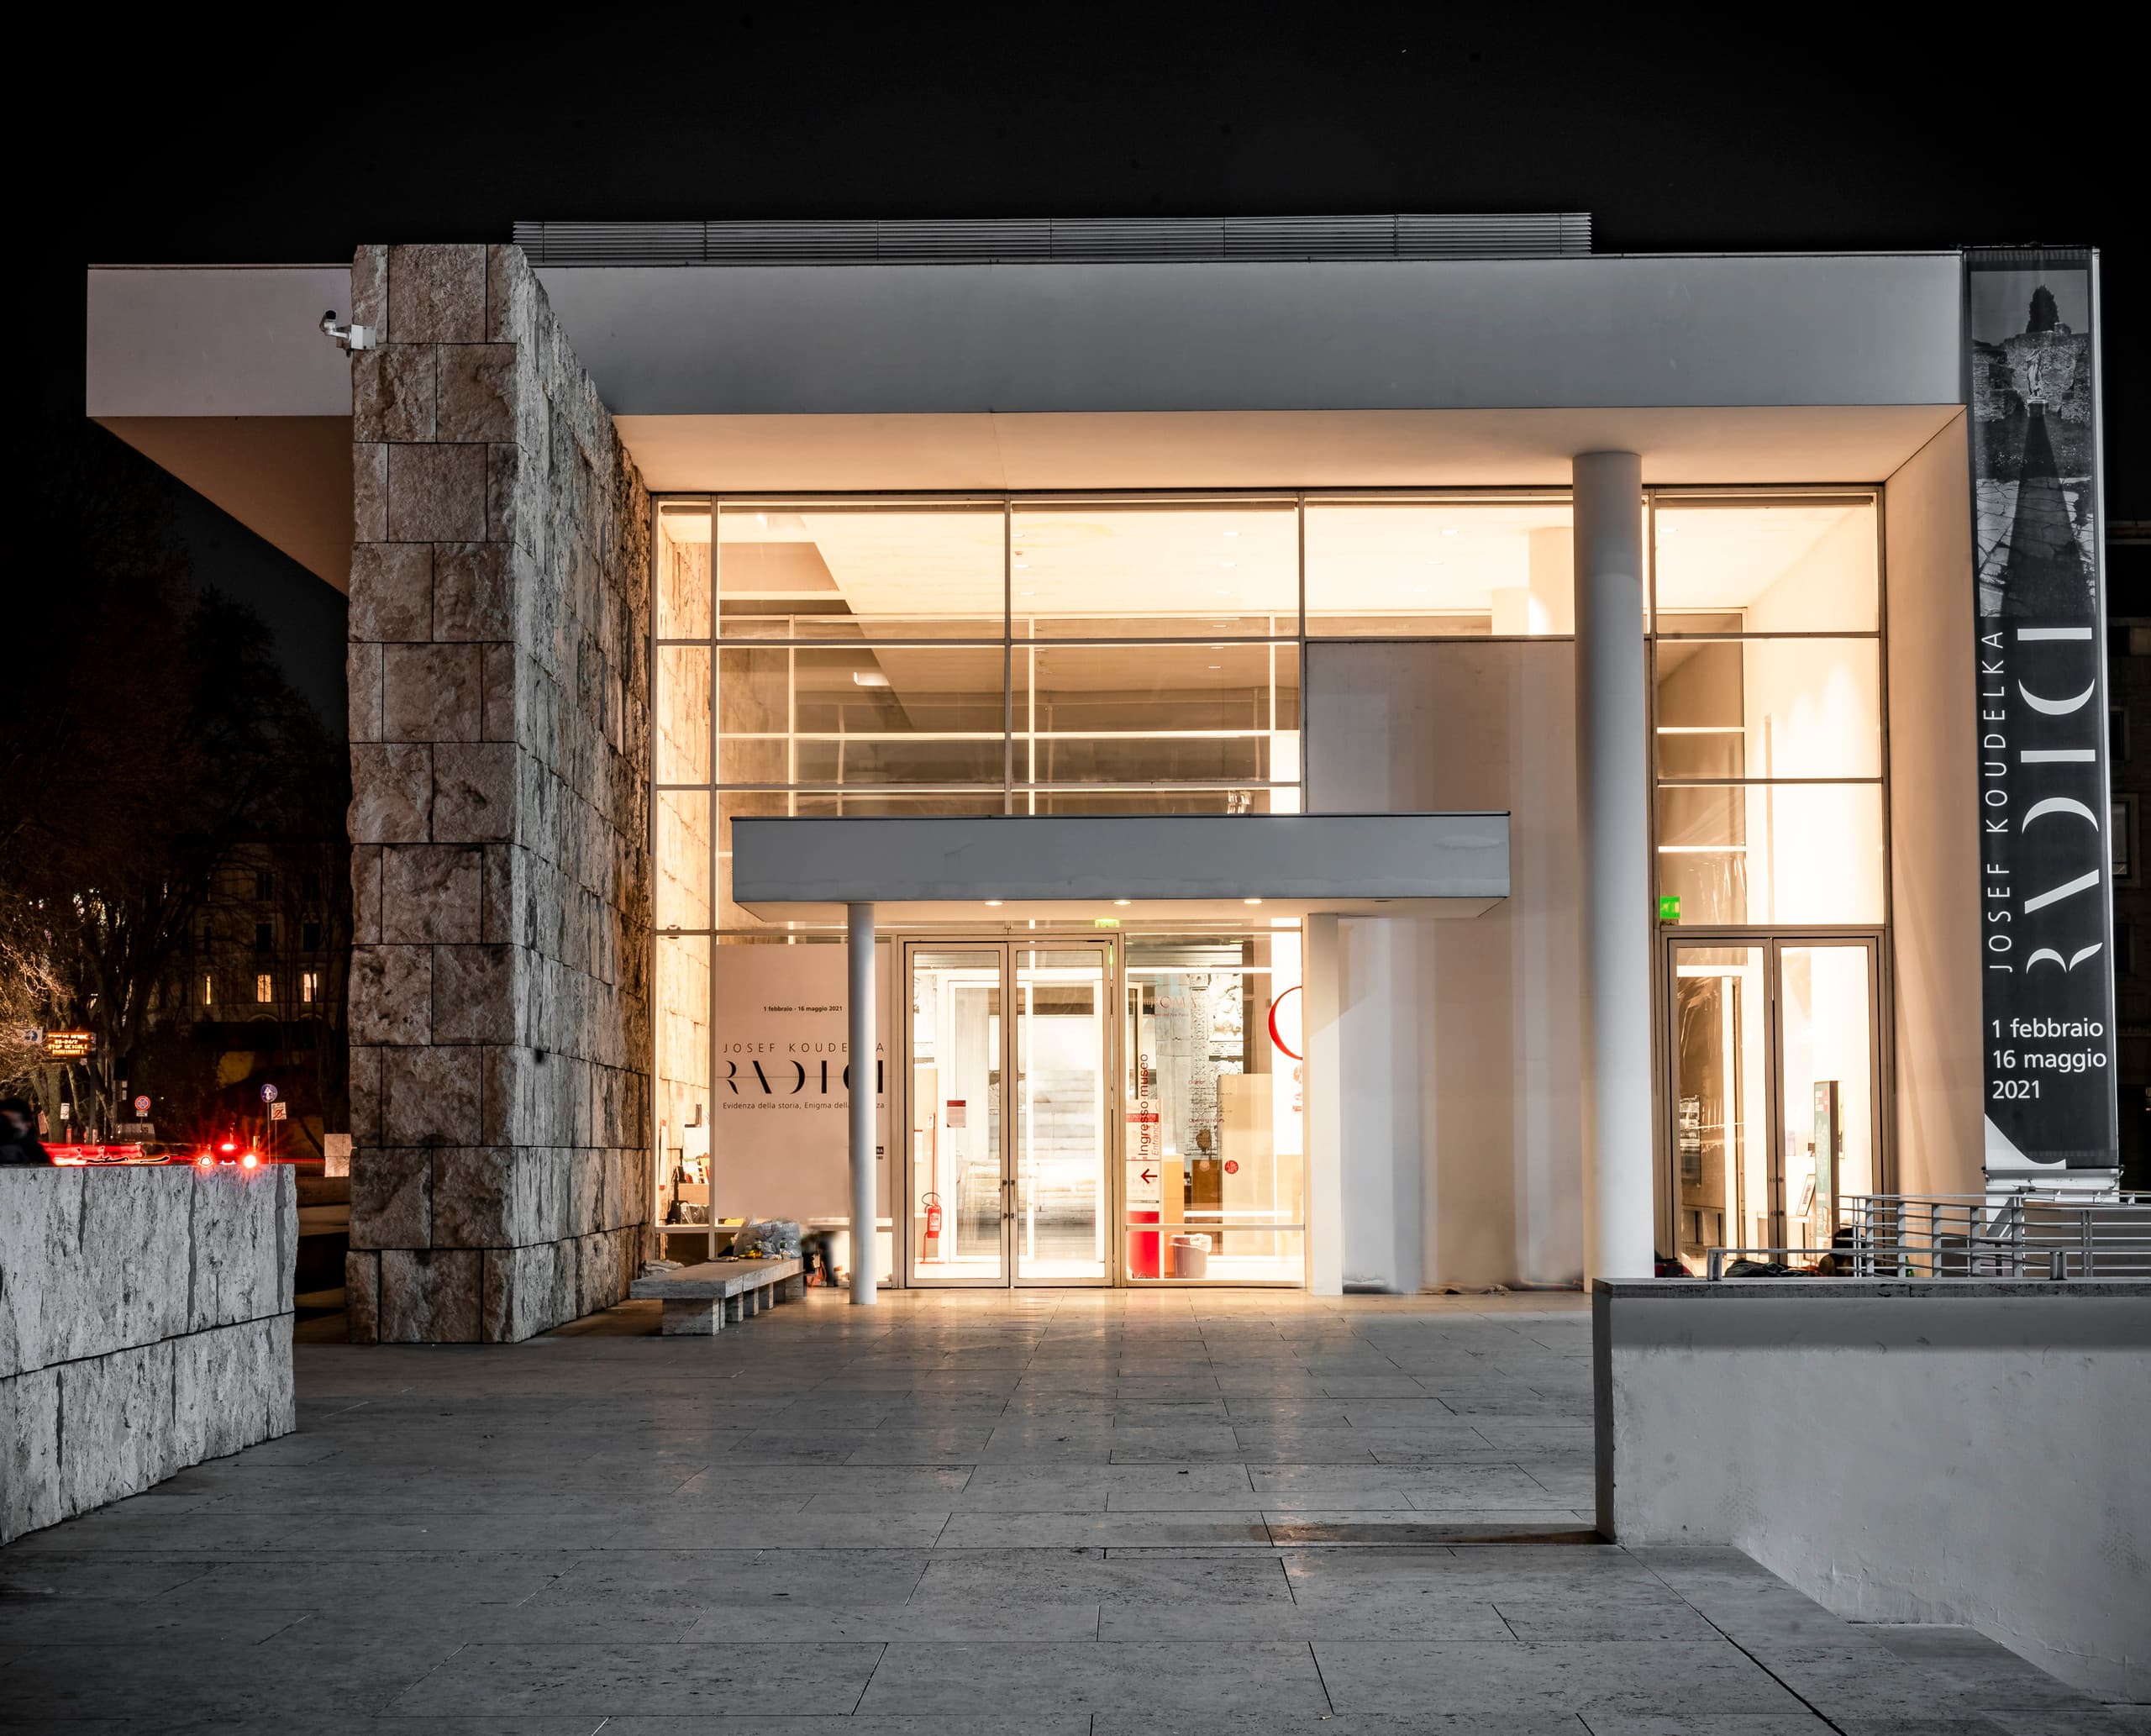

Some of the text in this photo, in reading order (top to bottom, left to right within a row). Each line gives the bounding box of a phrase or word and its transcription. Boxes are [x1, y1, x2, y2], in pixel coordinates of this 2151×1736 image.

[1980, 631, 2013, 973] JOSEF KOUDELKA
[2017, 627, 2103, 975] RADICI
[806, 1005, 828, 1013] maggio
[1992, 1017, 2104, 1039] 1 febbraio
[723, 1042, 885, 1053] JOSEF KOUDEA
[1993, 1047, 2107, 1073] 16 maggio
[1992, 1080, 2041, 1100] 2021
[778, 1102, 802, 1110] storia,
[804, 1102, 832, 1111] Enigma
[1138, 1054, 1151, 1156] Ingresso museo
